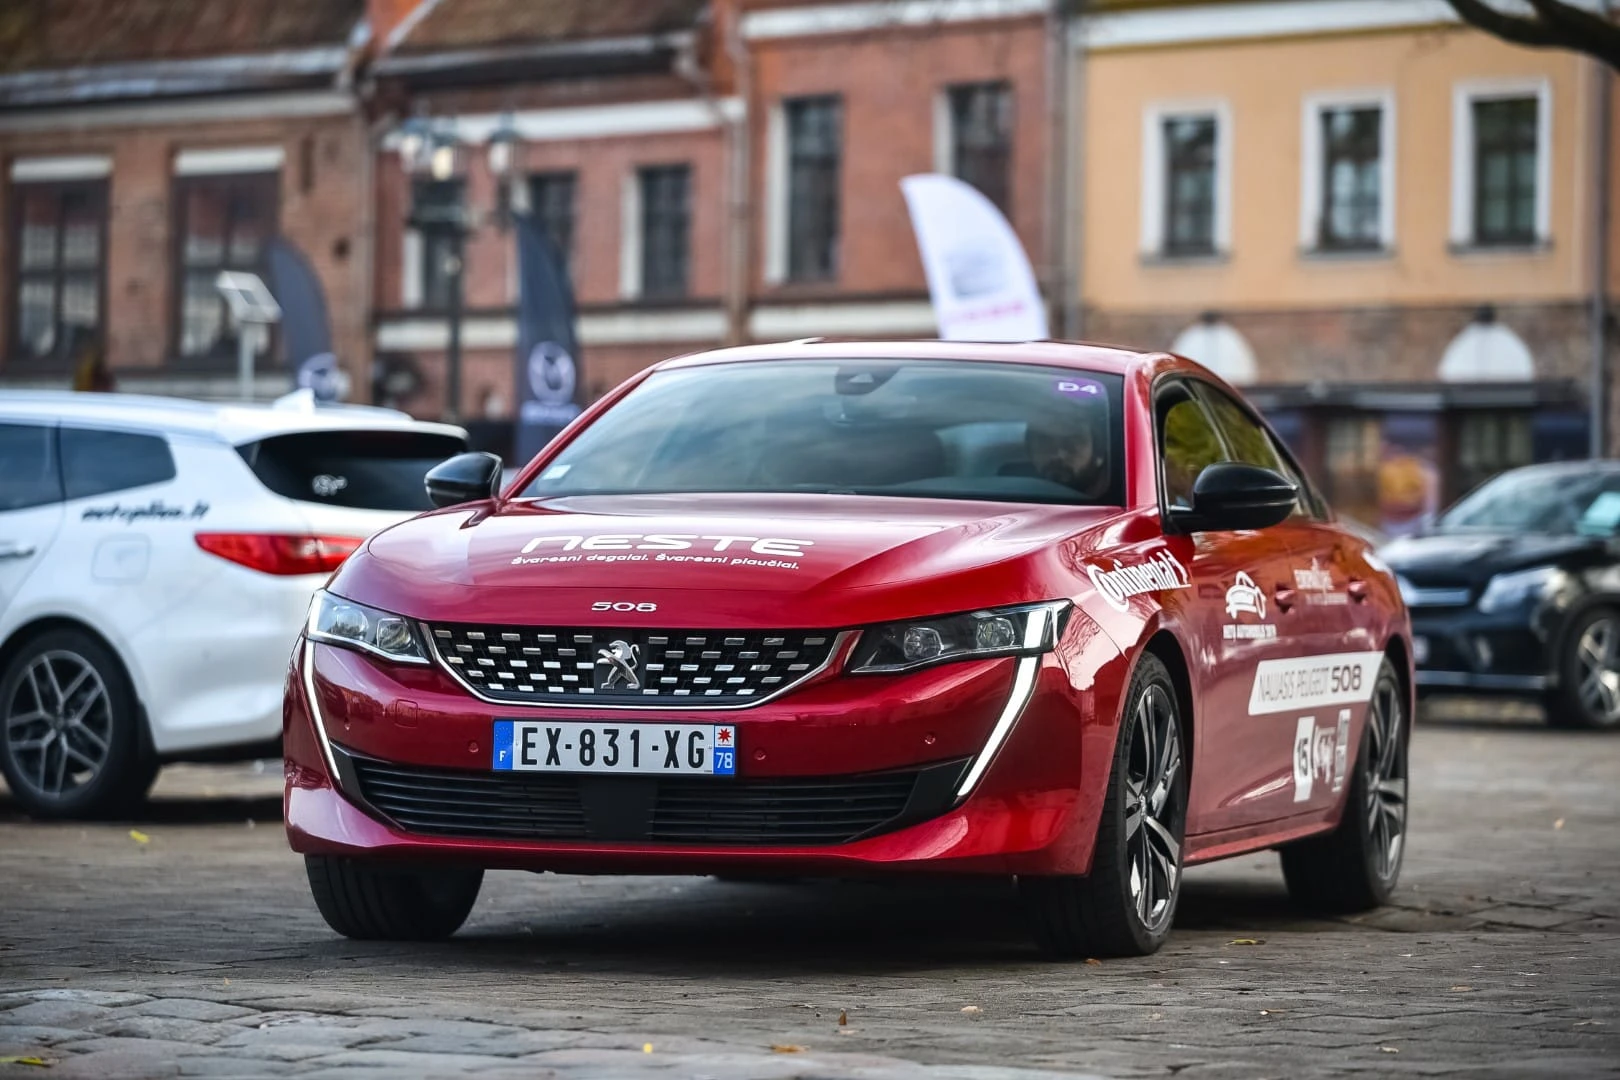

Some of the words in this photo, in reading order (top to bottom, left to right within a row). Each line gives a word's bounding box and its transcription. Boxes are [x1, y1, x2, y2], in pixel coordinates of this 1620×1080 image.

[1058, 381, 1098, 395] D4
[520, 534, 815, 557] NESTE
[1086, 552, 1181, 612] Continental
[591, 601, 658, 613] 508
[1331, 663, 1362, 693] 508
[499, 751, 507, 762] F
[521, 727, 705, 769] EX-831-XG
[716, 752, 733, 769] 78
